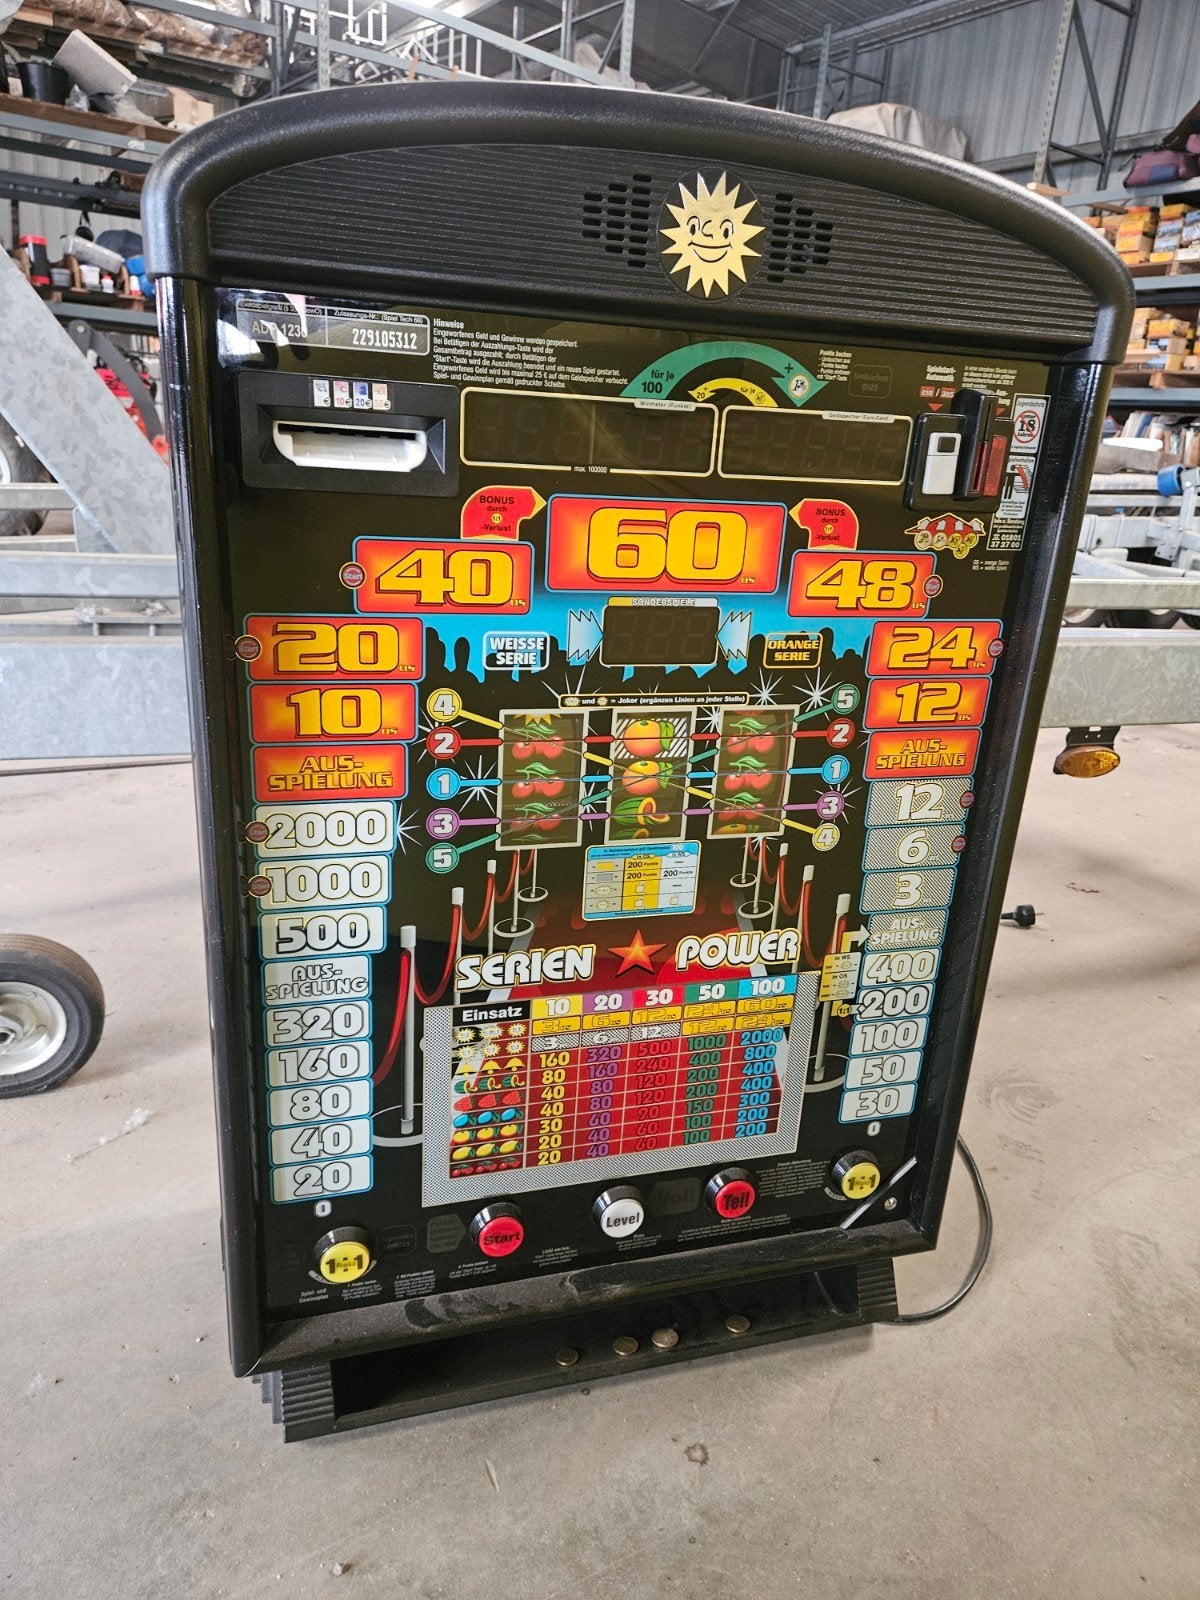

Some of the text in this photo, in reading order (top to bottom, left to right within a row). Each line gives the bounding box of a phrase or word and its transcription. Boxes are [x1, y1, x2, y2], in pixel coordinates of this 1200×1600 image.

[433, 318, 464, 329] Hinweise
[352, 327, 417, 350] 229105312
[433, 328, 475, 338] Eingeworfenes
[476, 332, 488, 340] Geld
[501, 334, 525, 343] Gewinne
[433, 362, 474, 373] Eingeworfenes
[475, 366, 487, 374] Geld
[488, 367, 500, 375] wird
[511, 370, 533, 378] maximal
[535, 371, 542, 379] 25
[549, 372, 557, 380] auf
[571, 374, 604, 383] Geldspeicher
[491, 359, 522, 369] Auszahlung
[583, 366, 596, 375] Spiel
[651, 370, 675, 381] für je
[641, 382, 663, 394] 100
[696, 391, 705, 399] 20
[1018, 419, 1036, 432] 18
[480, 495, 515, 504] BONUS
[816, 508, 845, 516] BONUS
[587, 506, 748, 585] 60
[375, 548, 514, 606] 40
[805, 559, 916, 610] 48
[632, 598, 696, 607] SONDERSPIELE
[272, 622, 399, 674] 20
[490, 637, 544, 651] WEISSE
[767, 639, 820, 651] ORANGE
[887, 626, 976, 669] 24
[496, 651, 537, 665] SERIE
[774, 651, 810, 661] SERIE
[433, 693, 455, 717] 4
[706, 696, 723, 704] jeder
[724, 695, 745, 703] Stelle)
[835, 690, 854, 709] 5
[895, 681, 962, 724] 12
[286, 688, 382, 738] 10
[433, 732, 455, 754] 2
[832, 724, 850, 742] 2
[900, 738, 947, 753] AUS-
[300, 755, 364, 773] AUS-
[830, 760, 842, 779] 1
[875, 752, 966, 769] SPIELUNG
[268, 772, 394, 792] SPIELUNG
[437, 773, 451, 794] 1
[821, 796, 839, 815] 3
[896, 782, 943, 822] 12
[264, 810, 387, 849] 2000
[433, 813, 453, 834] 3
[817, 828, 834, 846] 4
[898, 829, 930, 864] 6
[432, 848, 452, 868] 5
[265, 862, 382, 903] 1000
[893, 872, 923, 907] 3
[276, 913, 370, 954] 500
[890, 917, 925, 931] AUS-
[871, 928, 940, 946] SPIELUNG
[455, 928, 801, 992] SERIEN POWER
[866, 950, 935, 984] 400
[291, 962, 343, 982] AUS-
[266, 977, 368, 1000] SPIELUNG
[462, 977, 785, 1023] Einsatz 10 20 30 50 100
[862, 985, 929, 1019] 200
[273, 1004, 363, 1044] 320
[861, 1020, 919, 1052] 100
[539, 1027, 784, 1068] 160 320 500 1000 2000
[279, 1044, 359, 1083] 160
[541, 1044, 776, 1085] 80 160 240 400 800
[861, 1055, 905, 1085] 50
[540, 1060, 775, 1101] 40 80 120 200 400
[290, 1085, 351, 1121] 80
[540, 1075, 773, 1117] 40 80 120 200 400
[856, 1088, 900, 1118] 30
[539, 1091, 770, 1134] 30 60 90 150 300
[538, 1107, 768, 1150] 20 40 60 100 200
[867, 1121, 881, 1137] 0
[291, 1124, 351, 1158] 40
[538, 1122, 766, 1166] 20 40 60 100 200
[293, 1161, 351, 1197] 20
[848, 1174, 876, 1190] 1:1
[314, 1200, 332, 1218] 0
[723, 1192, 750, 1210] Teil
[606, 1212, 640, 1228] Level
[483, 1232, 520, 1246] Start
[325, 1254, 364, 1274] 1:1
